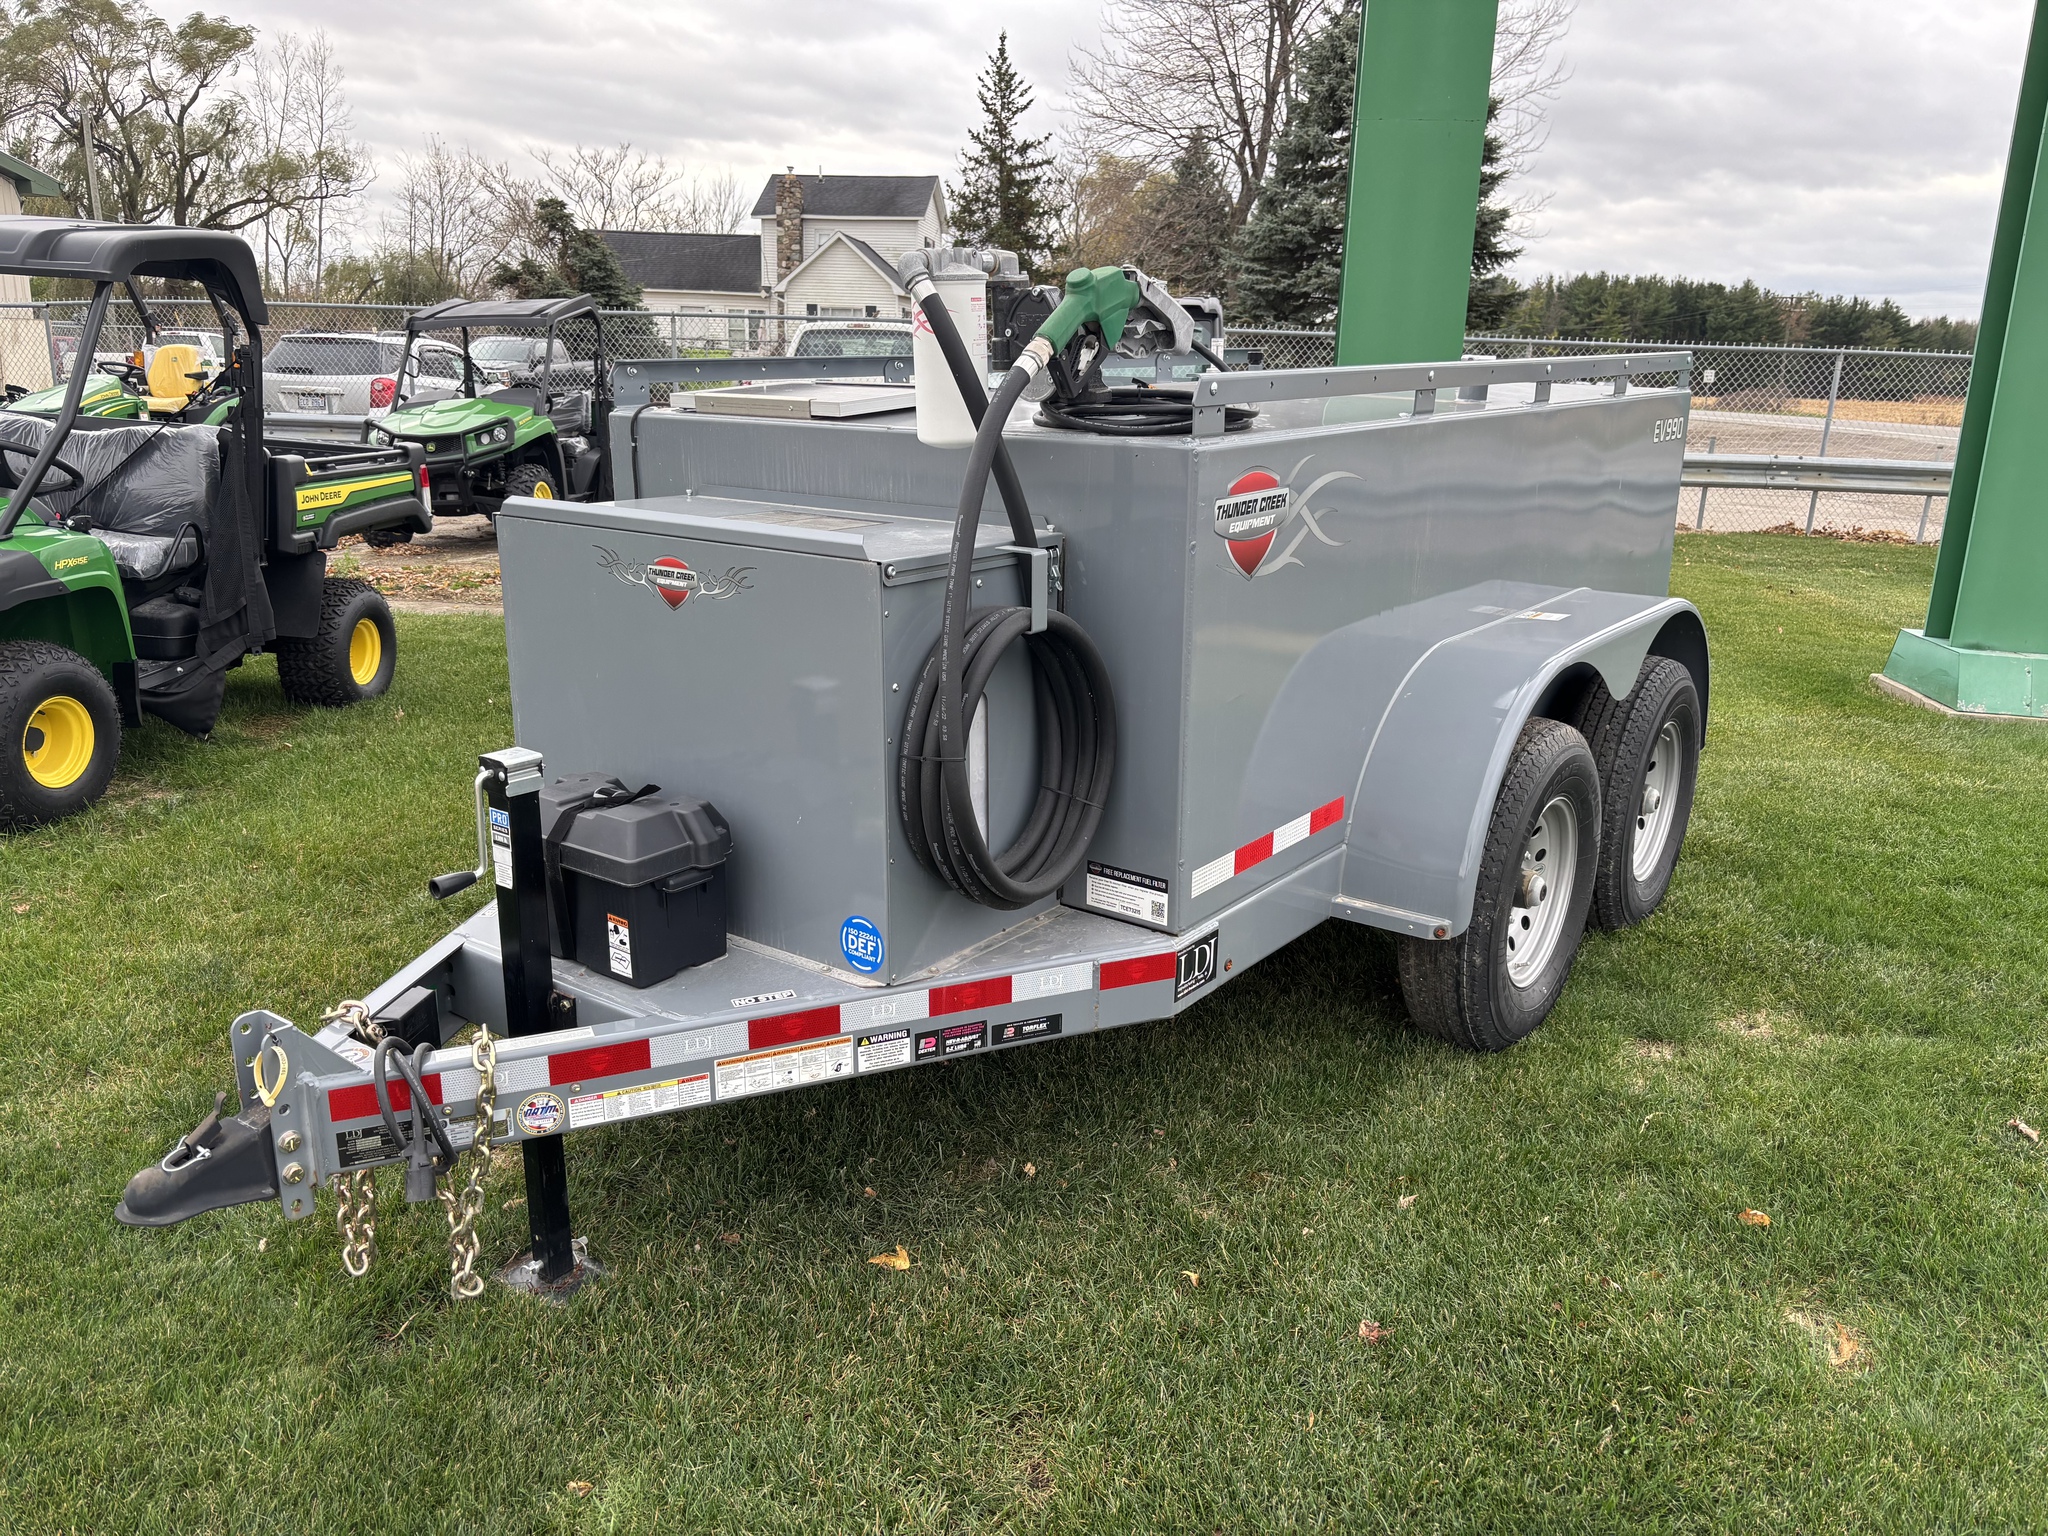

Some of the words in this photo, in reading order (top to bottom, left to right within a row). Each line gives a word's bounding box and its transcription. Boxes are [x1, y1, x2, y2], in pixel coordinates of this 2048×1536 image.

[1653, 417, 1684, 443] EV990
[301, 494, 320, 504] JOHN
[320, 490, 342, 500] DEERE
[1216, 498, 1259, 521] THUNDER
[1259, 493, 1288, 513] CREEK
[1228, 514, 1276, 534] EQUIPMENT
[54, 556, 88, 570] HPX615E
[648, 567, 675, 578] THUNDER
[676, 572, 696, 582] CREEK
[656, 578, 688, 588] EQUIPMENT
[492, 810, 508, 826] PRO
[1103, 868, 1114, 876] FREE
[1114, 870, 1142, 884] REPLACEMENT
[1142, 878, 1152, 886] FUEL
[1152, 880, 1166, 889] FILTER
[848, 927, 858, 936] ISO
[848, 934, 876, 955] DEF
[848, 948, 876, 962] COMPLIANT
[1178, 937, 1218, 988] LDJ
[1040, 974, 1064, 989] LDJ
[734, 998, 756, 1006] NO
[871, 1002, 897, 1018] LDJ
[1022, 1022, 1048, 1032] TORFLEX
[684, 1034, 712, 1051] LDJ
[870, 1030, 908, 1044] WARNING
[918, 1046, 936, 1054] DEXTER
[345, 1129, 362, 1139] LDJ
